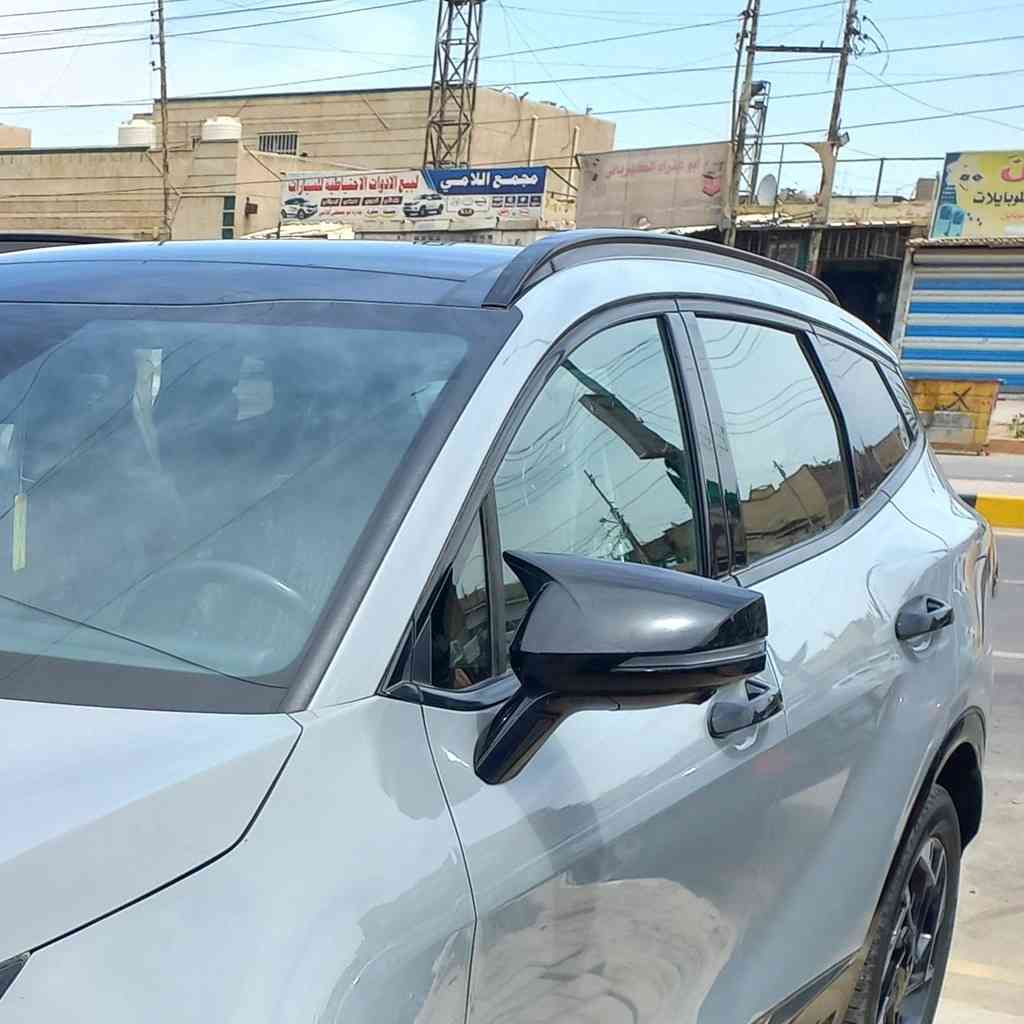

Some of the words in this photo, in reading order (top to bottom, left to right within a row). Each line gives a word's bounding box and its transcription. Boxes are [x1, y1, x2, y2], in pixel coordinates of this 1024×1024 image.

[398, 174, 419, 193] لبيع
[440, 169, 491, 193] اللامي
[492, 172, 538, 189] مجمع
